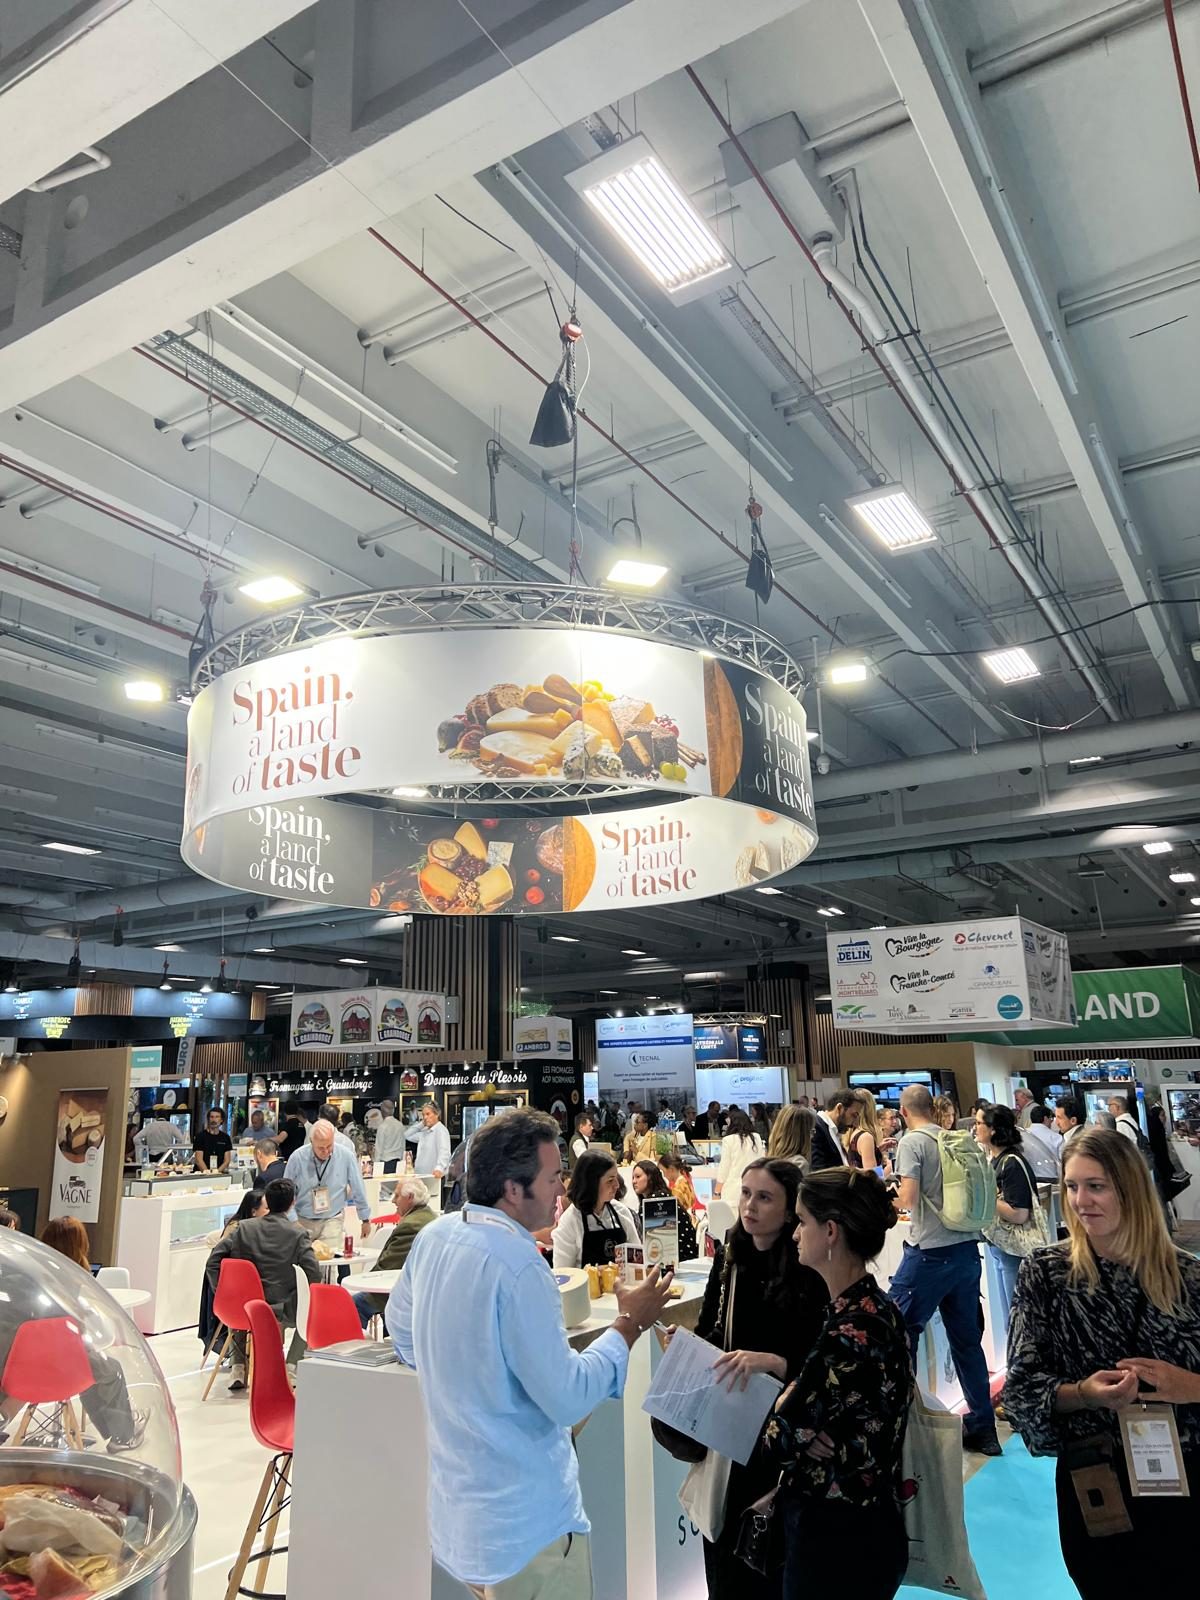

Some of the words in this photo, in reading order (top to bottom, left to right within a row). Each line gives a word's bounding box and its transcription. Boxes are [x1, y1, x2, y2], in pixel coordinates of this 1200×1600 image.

[248, 735, 260, 759] a
[271, 702, 338, 753] land
[232, 761, 257, 796] of
[261, 741, 361, 791] taste
[763, 743, 772, 765] a
[775, 734, 805, 783] land
[755, 767, 771, 795] of
[775, 767, 814, 821] taste
[260, 838, 270, 856] a
[276, 830, 321, 866] land
[618, 857, 629, 873] a
[636, 839, 683, 872] land
[249, 857, 268, 881] of
[270, 856, 335, 895] taste
[606, 876, 626, 898] of
[631, 866, 697, 897] taste
[895, 937, 944, 952] Bourgogne
[904, 935, 918, 944] Vive
[919, 932, 927, 940] la
[967, 929, 1013, 943] Chevenet
[838, 950, 870, 961] DELIN
[897, 970, 955, 990] Franche-Comté
[907, 971, 921, 980] Vive
[922, 968, 930, 977] la
[1077, 991, 1160, 1021] AND
[269, 1080, 315, 1095] Fromagerie
[315, 1079, 324, 1090] E.
[325, 1078, 373, 1093] Graindorge
[423, 1072, 470, 1087] Domaine
[471, 1070, 486, 1084] du
[488, 1069, 528, 1084] Plessis
[59, 1183, 92, 1204] VAGNE
